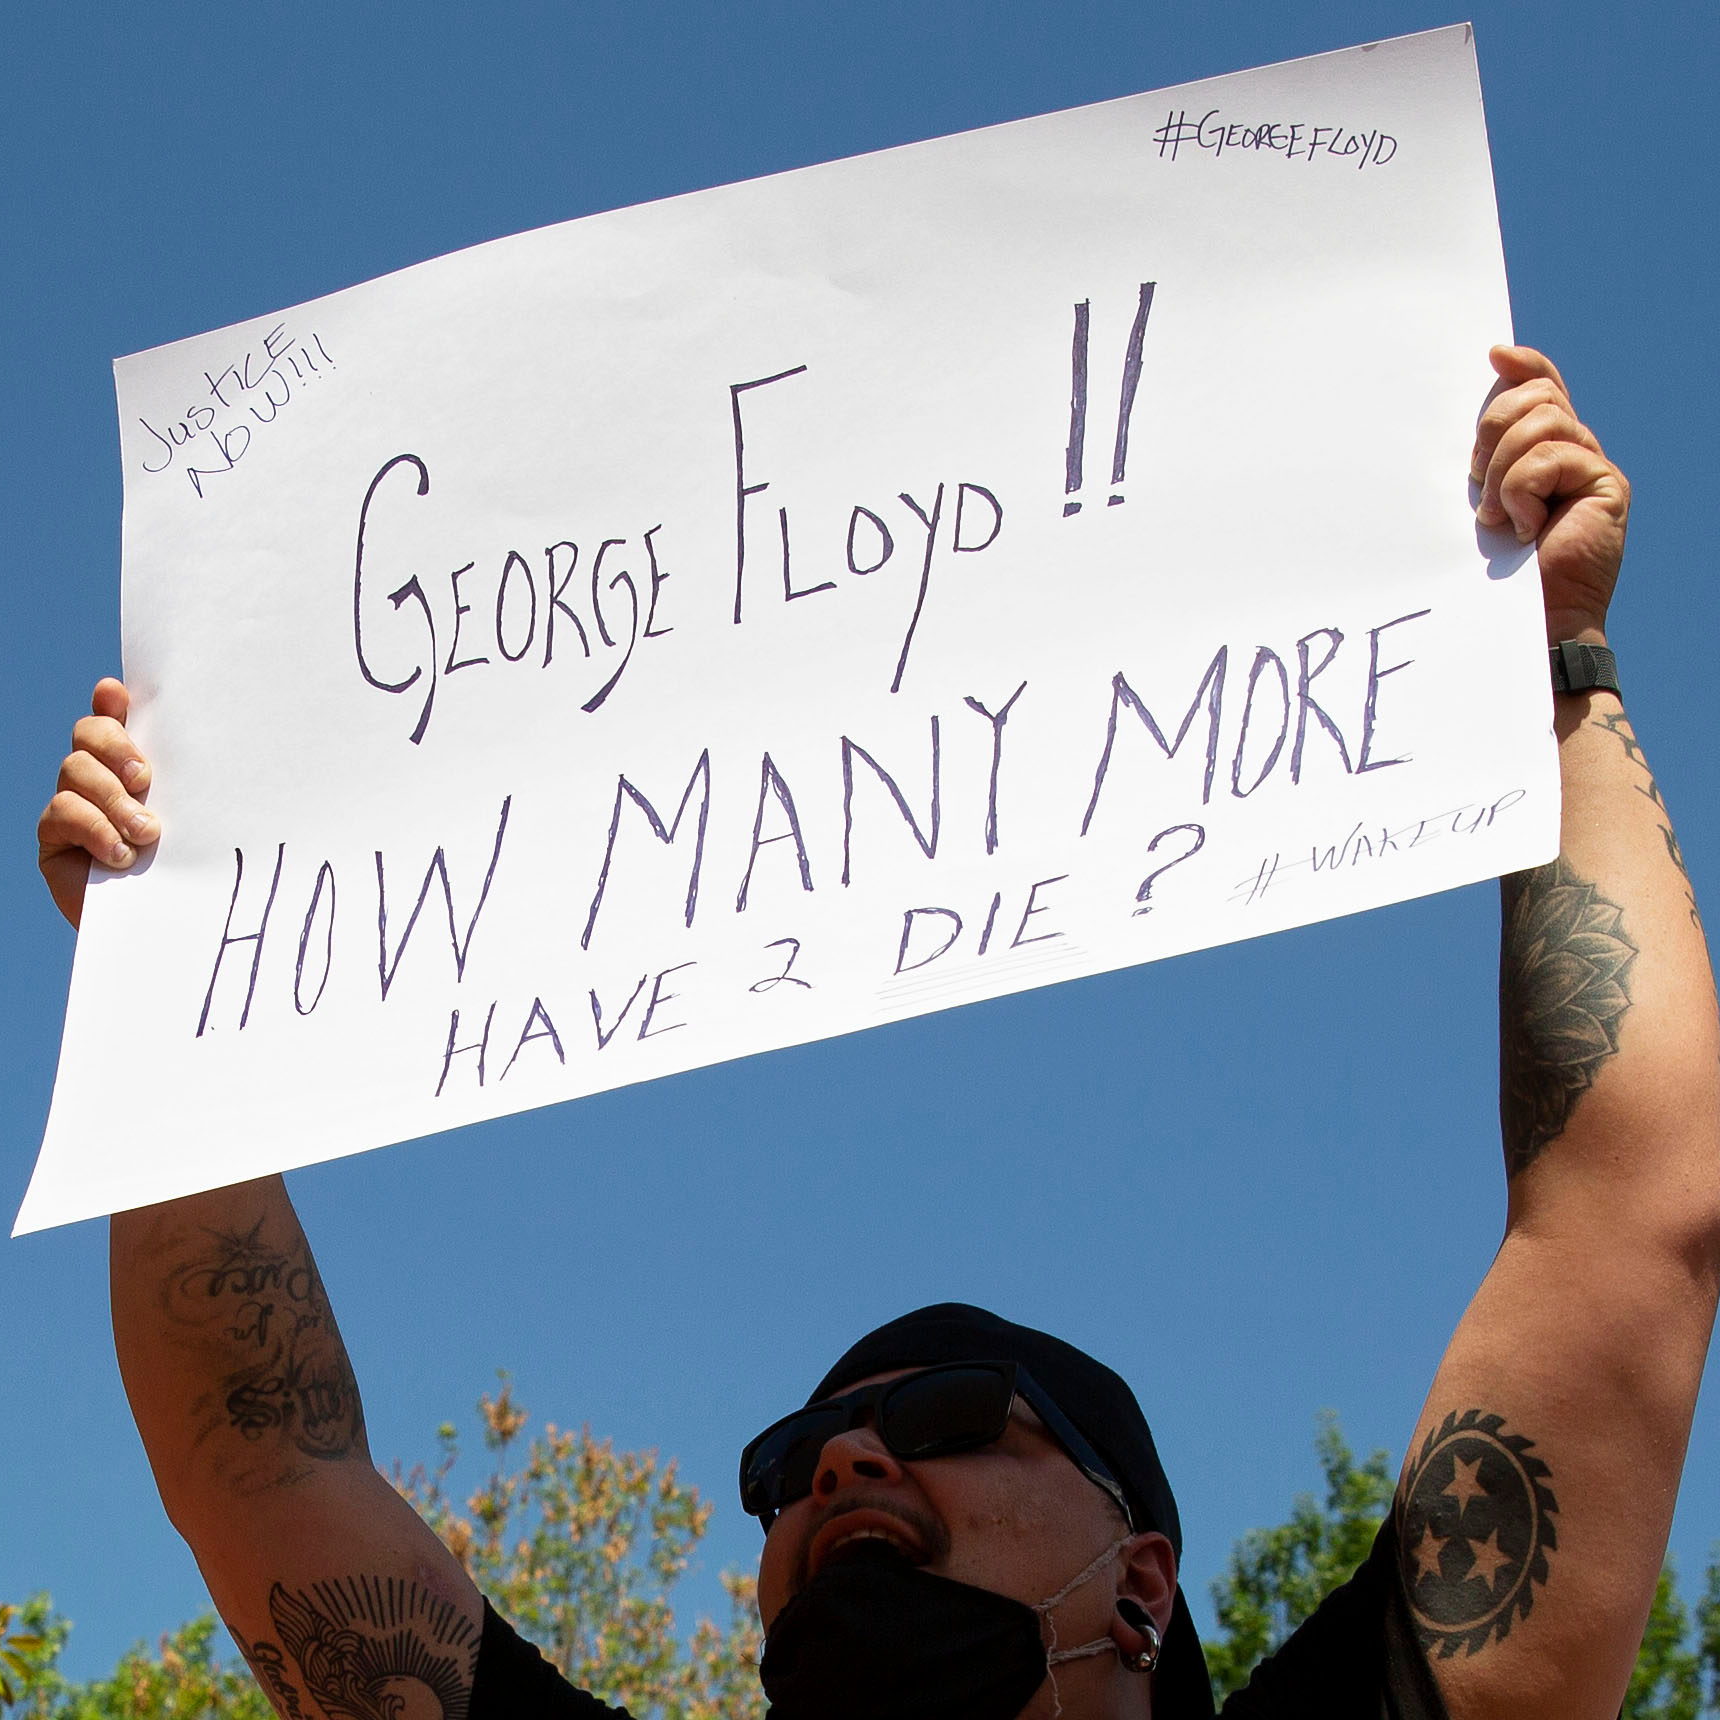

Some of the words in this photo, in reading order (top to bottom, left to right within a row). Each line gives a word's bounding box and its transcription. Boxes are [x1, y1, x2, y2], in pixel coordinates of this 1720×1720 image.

[195, 794, 513, 1041] HOW
[580, 680, 1028, 951] MANY
[1081, 609, 1434, 839] MORE
[435, 962, 697, 1099] HAVE
[748, 938, 813, 997] 2
[895, 872, 1072, 980] DIE
